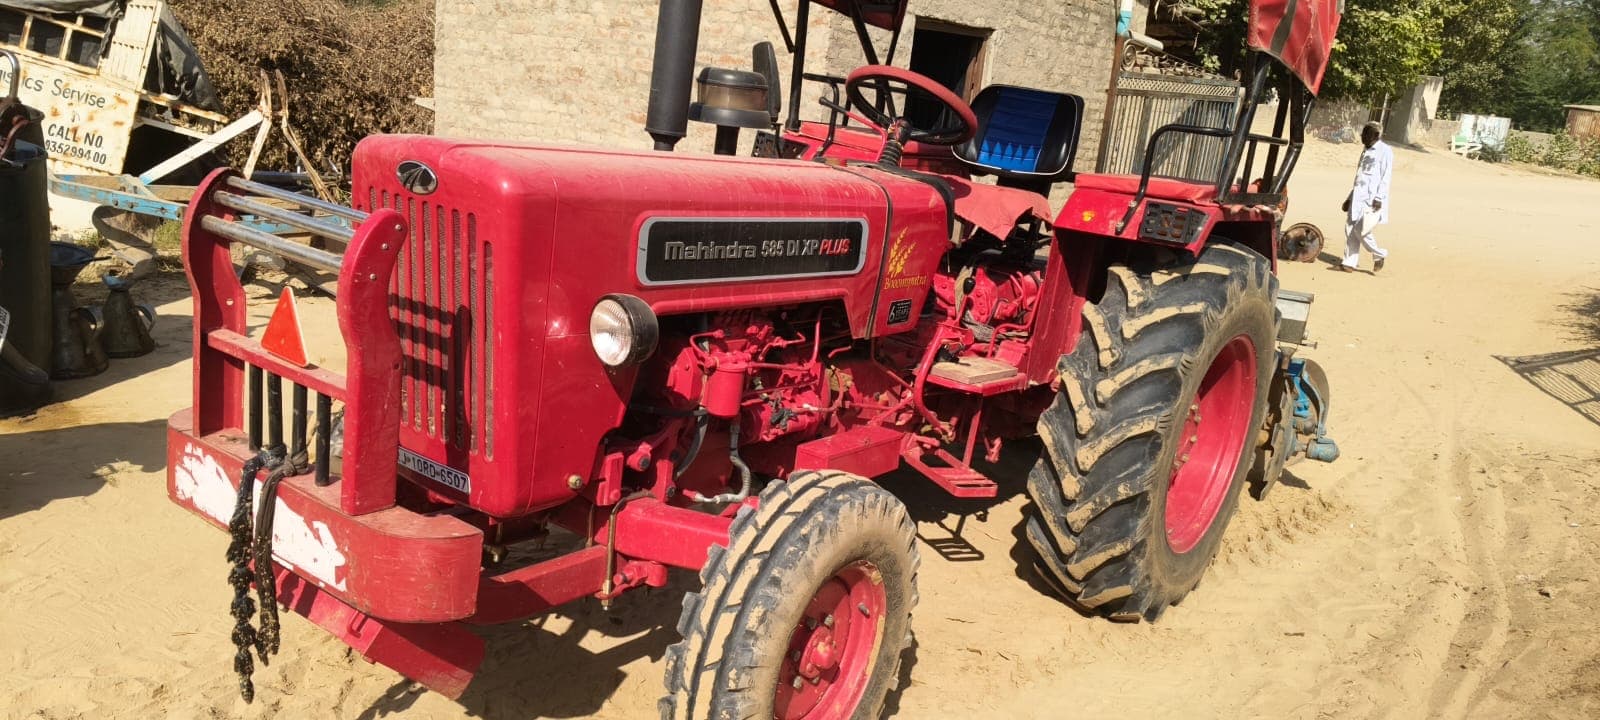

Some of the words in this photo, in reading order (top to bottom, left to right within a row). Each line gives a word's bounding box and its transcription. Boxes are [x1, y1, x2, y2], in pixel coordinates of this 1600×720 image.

[51, 79, 106, 109] Servise
[48, 123, 78, 143] CALL
[665, 241, 757, 261] Mahindra
[761, 240, 784, 257] 585
[786, 239, 800, 256] DI
[801, 239, 819, 256] XP
[819, 238, 851, 255] PLUS
